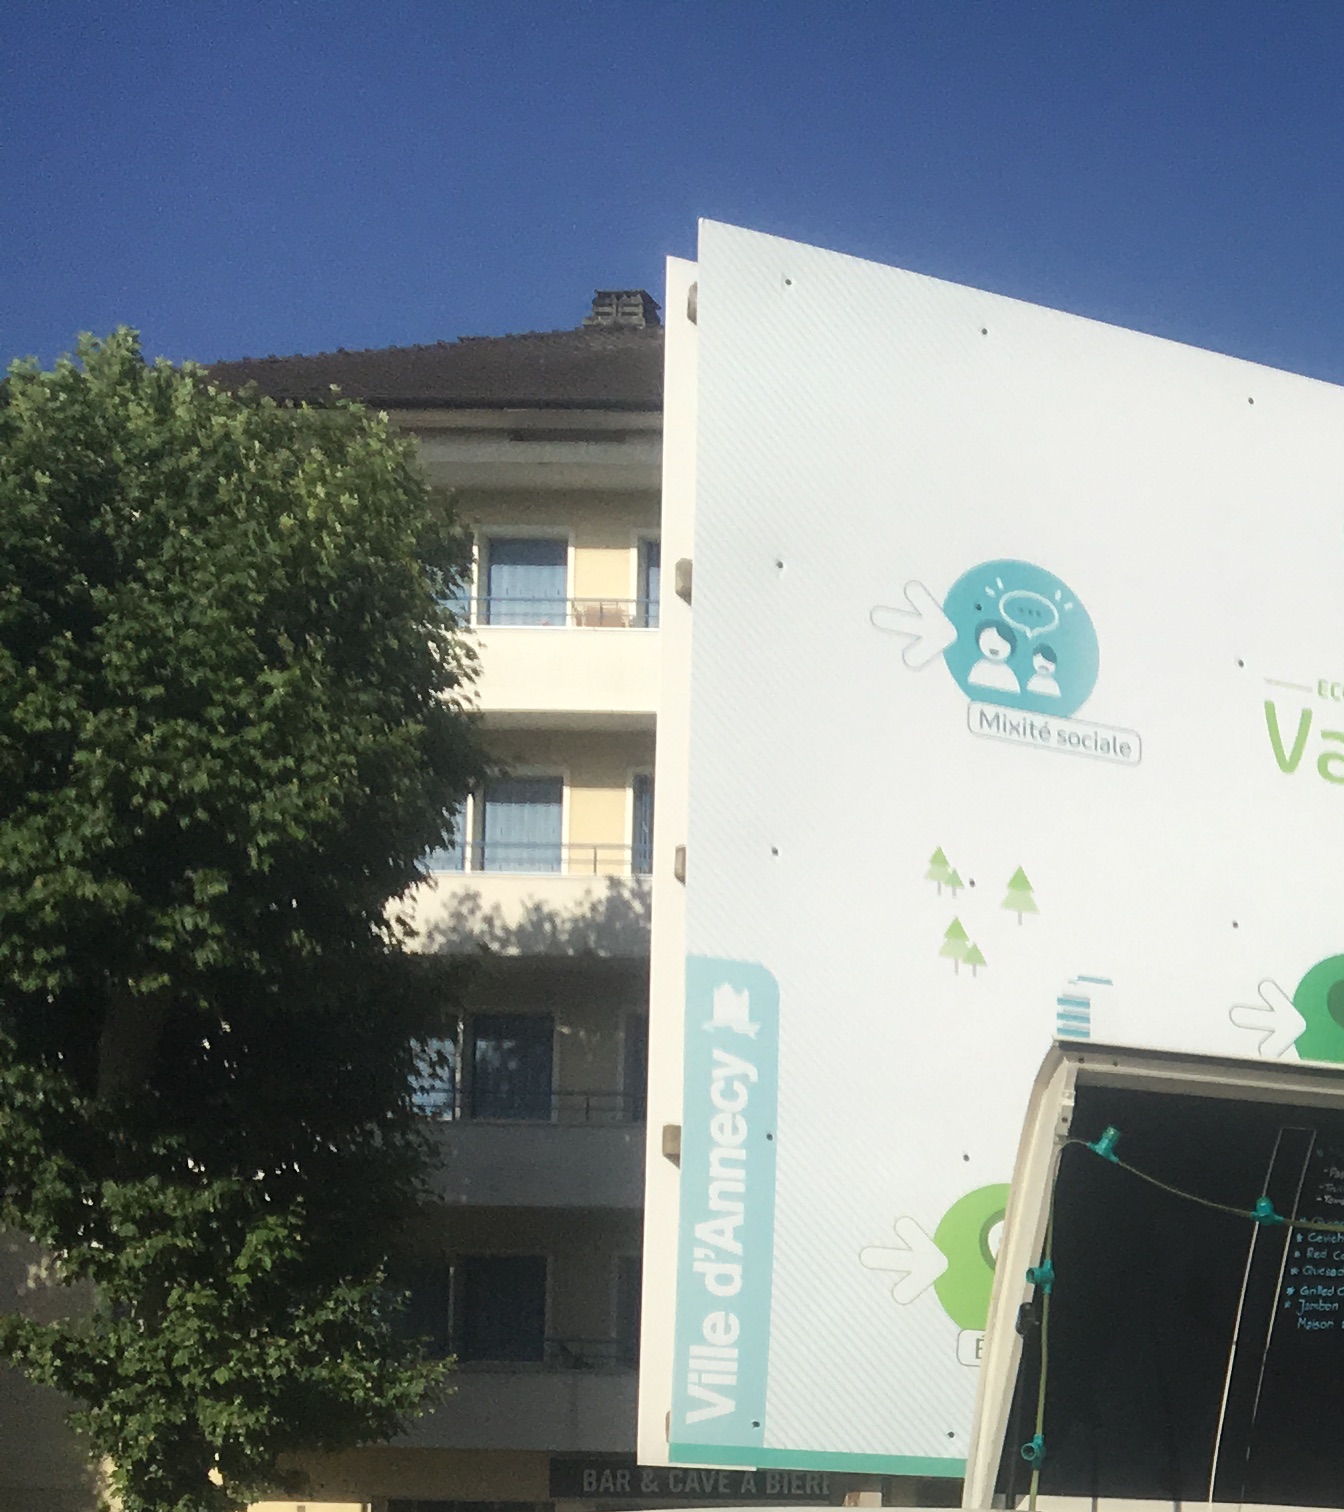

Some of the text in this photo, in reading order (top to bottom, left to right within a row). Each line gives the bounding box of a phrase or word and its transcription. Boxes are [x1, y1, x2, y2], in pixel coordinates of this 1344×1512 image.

[977, 708, 1133, 759] Mixité sociale
[685, 1048, 759, 1425] Ville d'Annecy
[1306, 1247, 1328, 1259] Red
[1299, 1285, 1335, 1297] Grilled
[1297, 1299, 1340, 1316] Jambon
[1297, 1317, 1335, 1330] Maison
[582, 1468, 631, 1493] BAR
[640, 1469, 660, 1493] &
[668, 1471, 731, 1494] CAVE
